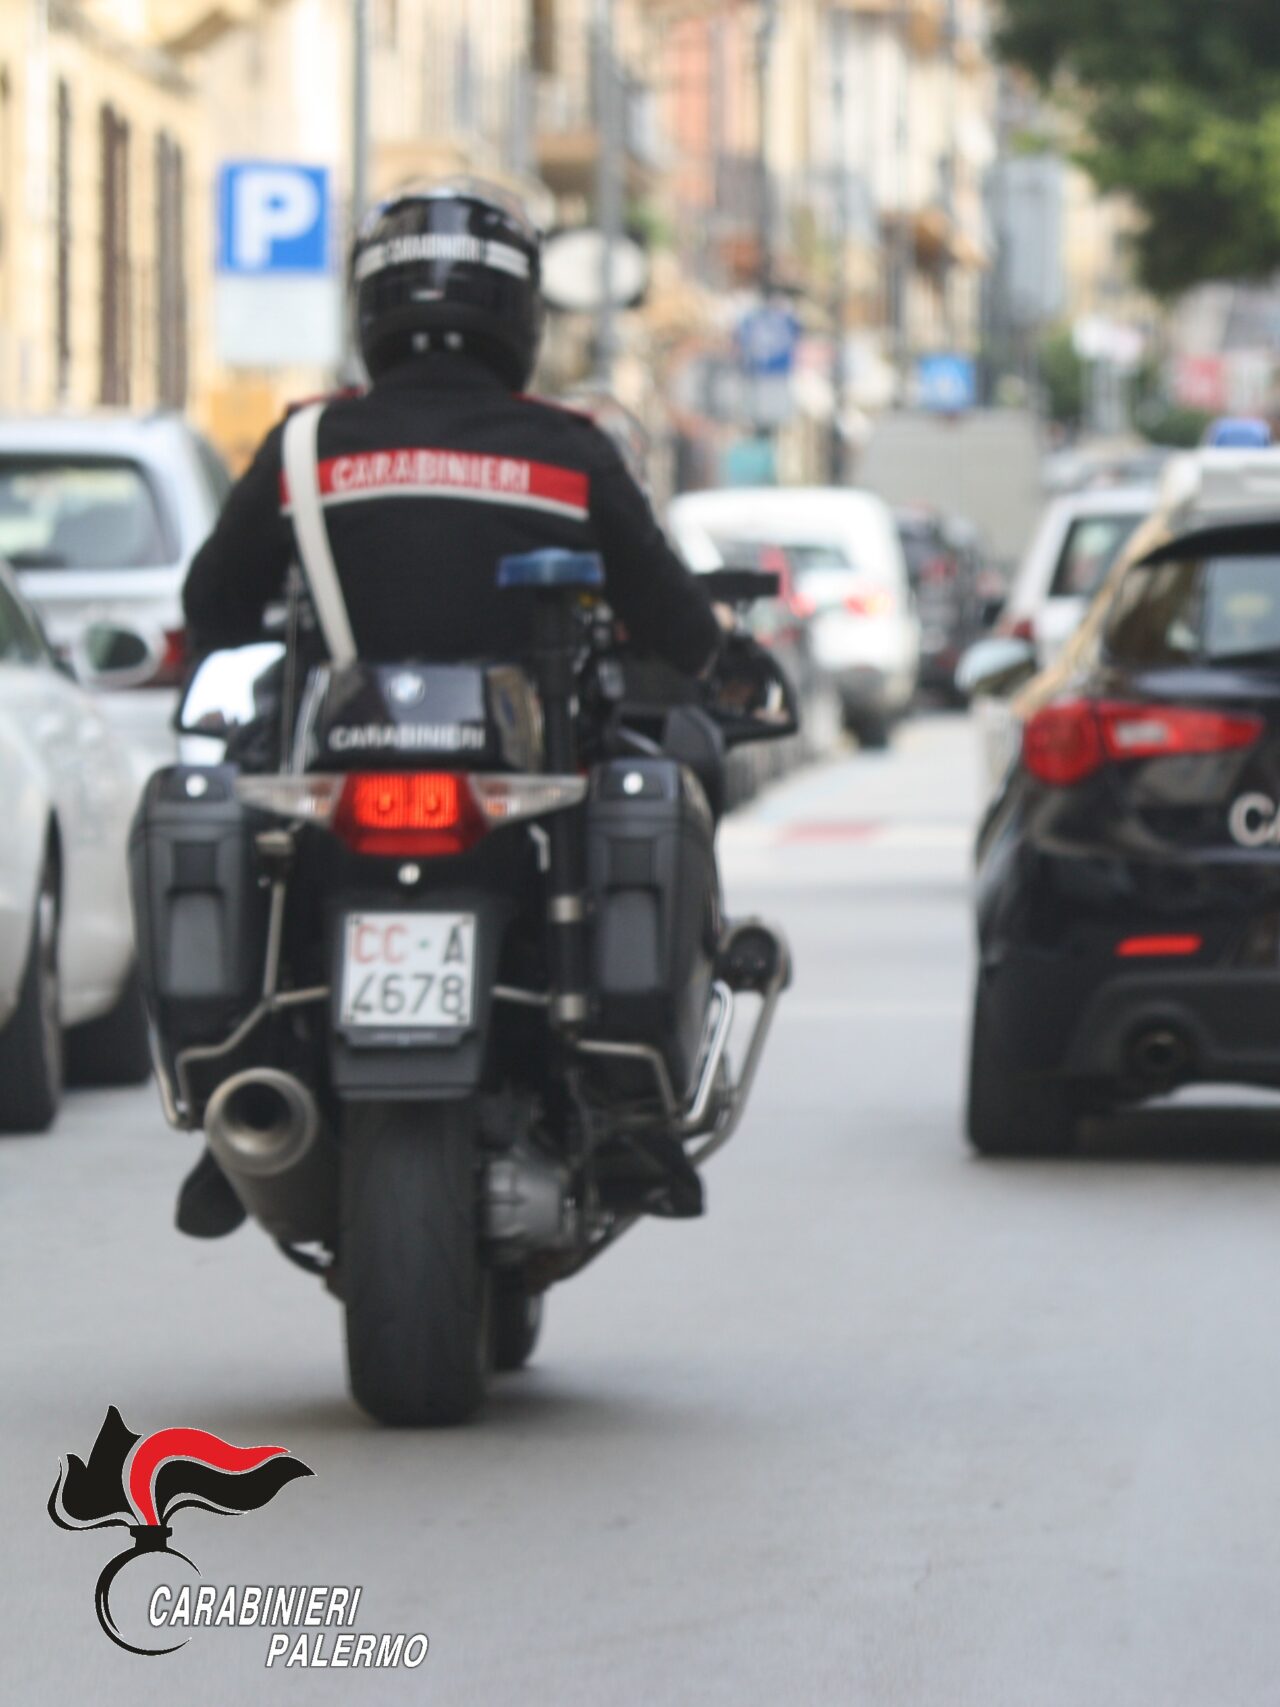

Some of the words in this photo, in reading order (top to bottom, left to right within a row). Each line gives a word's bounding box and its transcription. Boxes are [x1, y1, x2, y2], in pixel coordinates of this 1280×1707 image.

[232, 171, 318, 266] P
[331, 450, 530, 491] CARABINIERI
[328, 724, 484, 750] CARABINIERI
[353, 923, 408, 965] CC
[443, 924, 466, 966] A
[351, 972, 464, 1015] 4678
